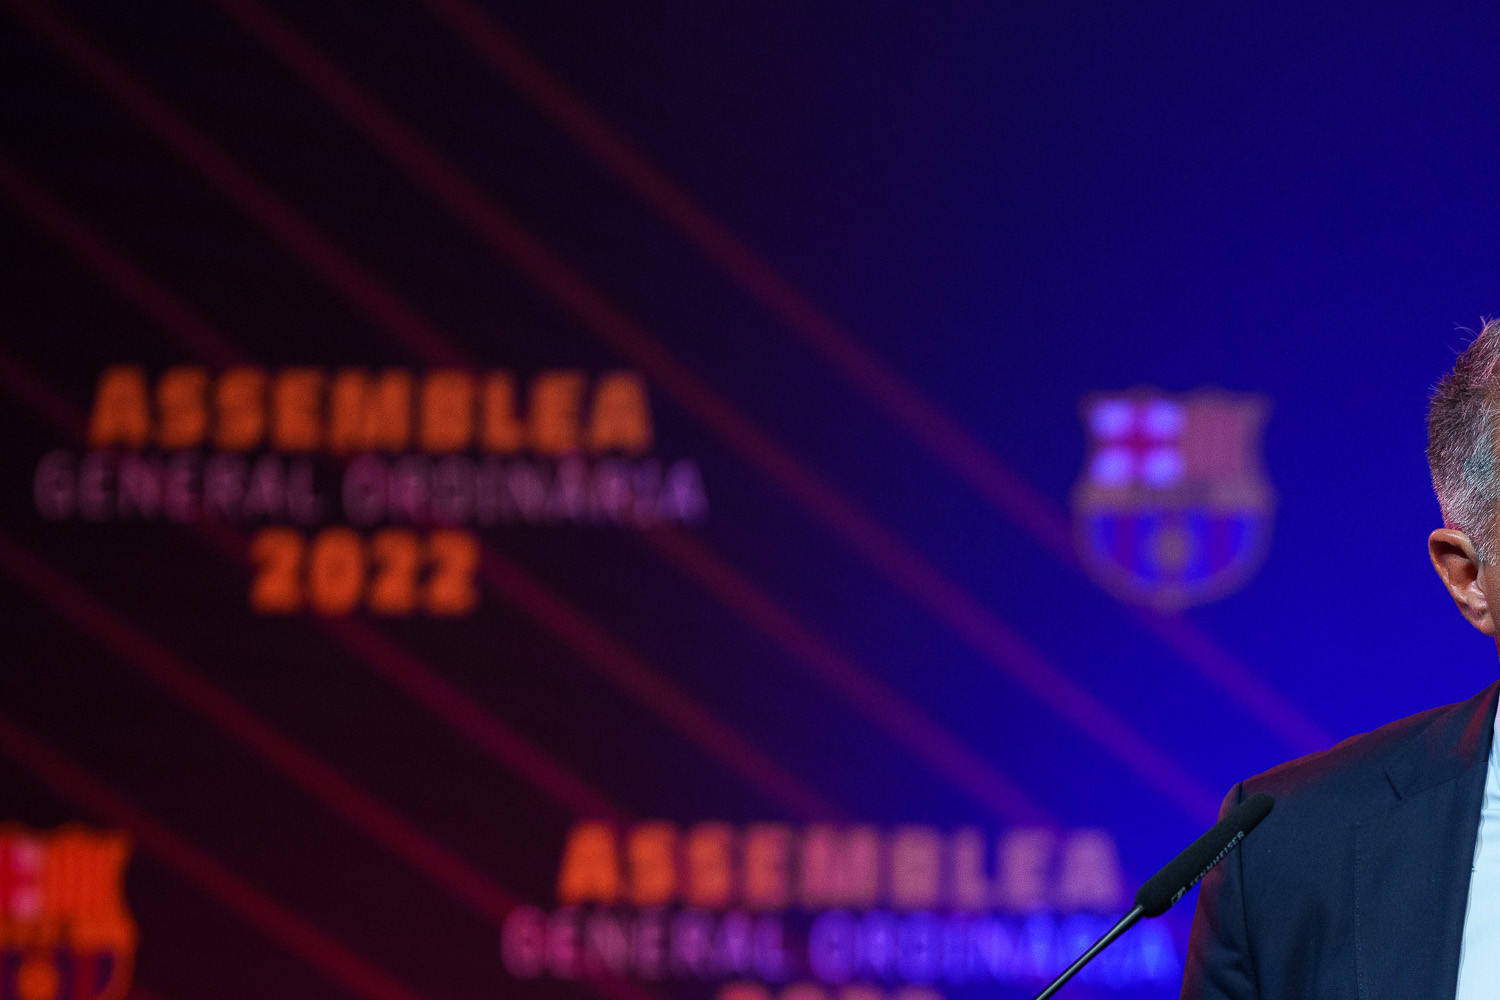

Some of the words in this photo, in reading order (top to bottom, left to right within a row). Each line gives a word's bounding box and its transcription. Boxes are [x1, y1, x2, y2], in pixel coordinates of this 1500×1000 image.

[90, 365, 652, 453] ASSEMBLEA
[34, 450, 324, 522] GENERAL
[250, 526, 478, 614] 2022
[558, 821, 1124, 909] ASSEMBLEA
[502, 904, 790, 979] GENERAL
